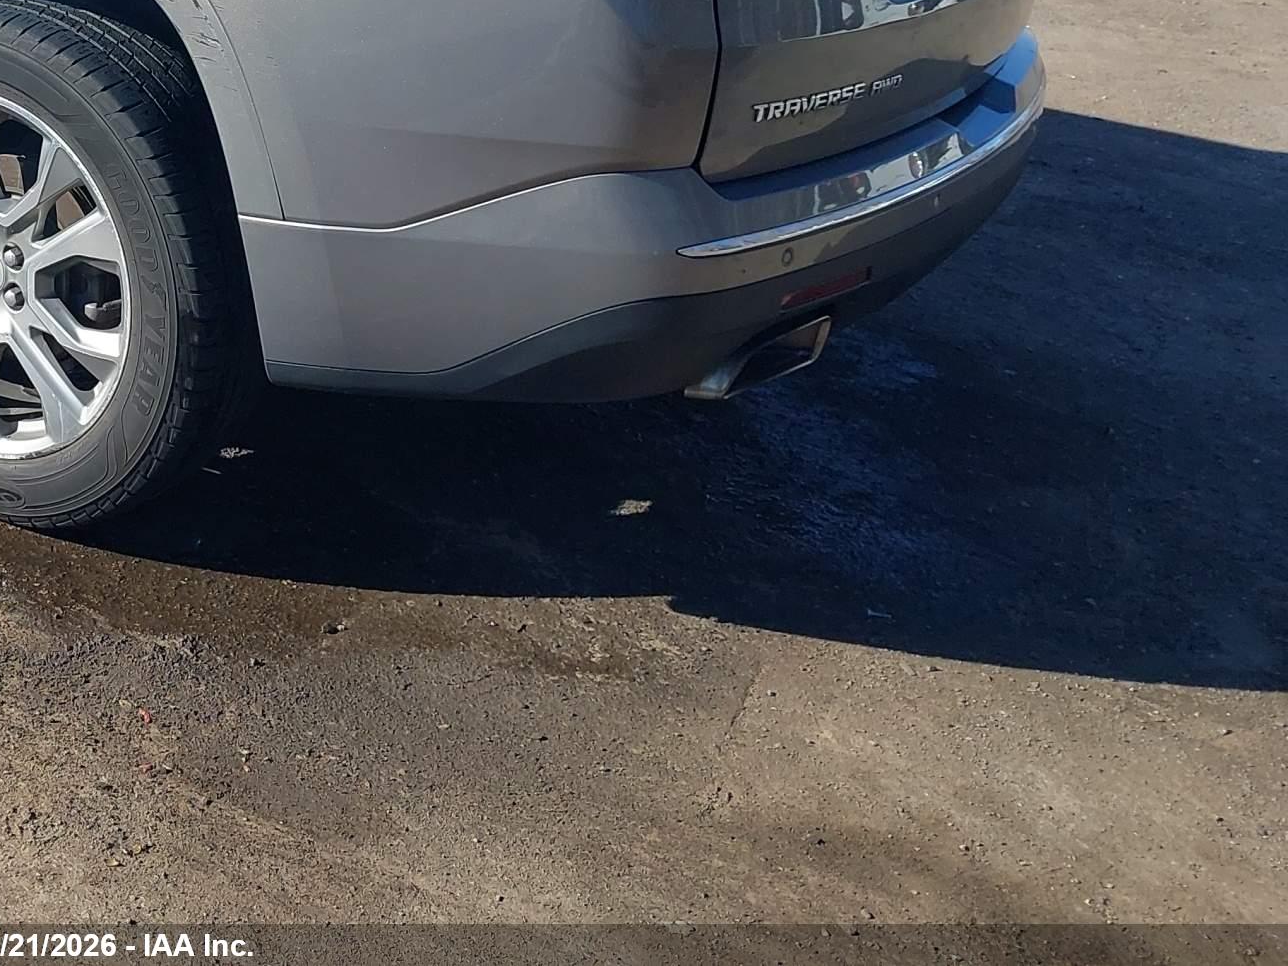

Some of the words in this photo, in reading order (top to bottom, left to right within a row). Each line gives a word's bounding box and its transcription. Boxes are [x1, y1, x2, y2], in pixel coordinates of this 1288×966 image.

[752, 82, 867, 123] TRAVERSE
[871, 73, 904, 97] AWD
[104, 164, 167, 417] GOODYEAR
